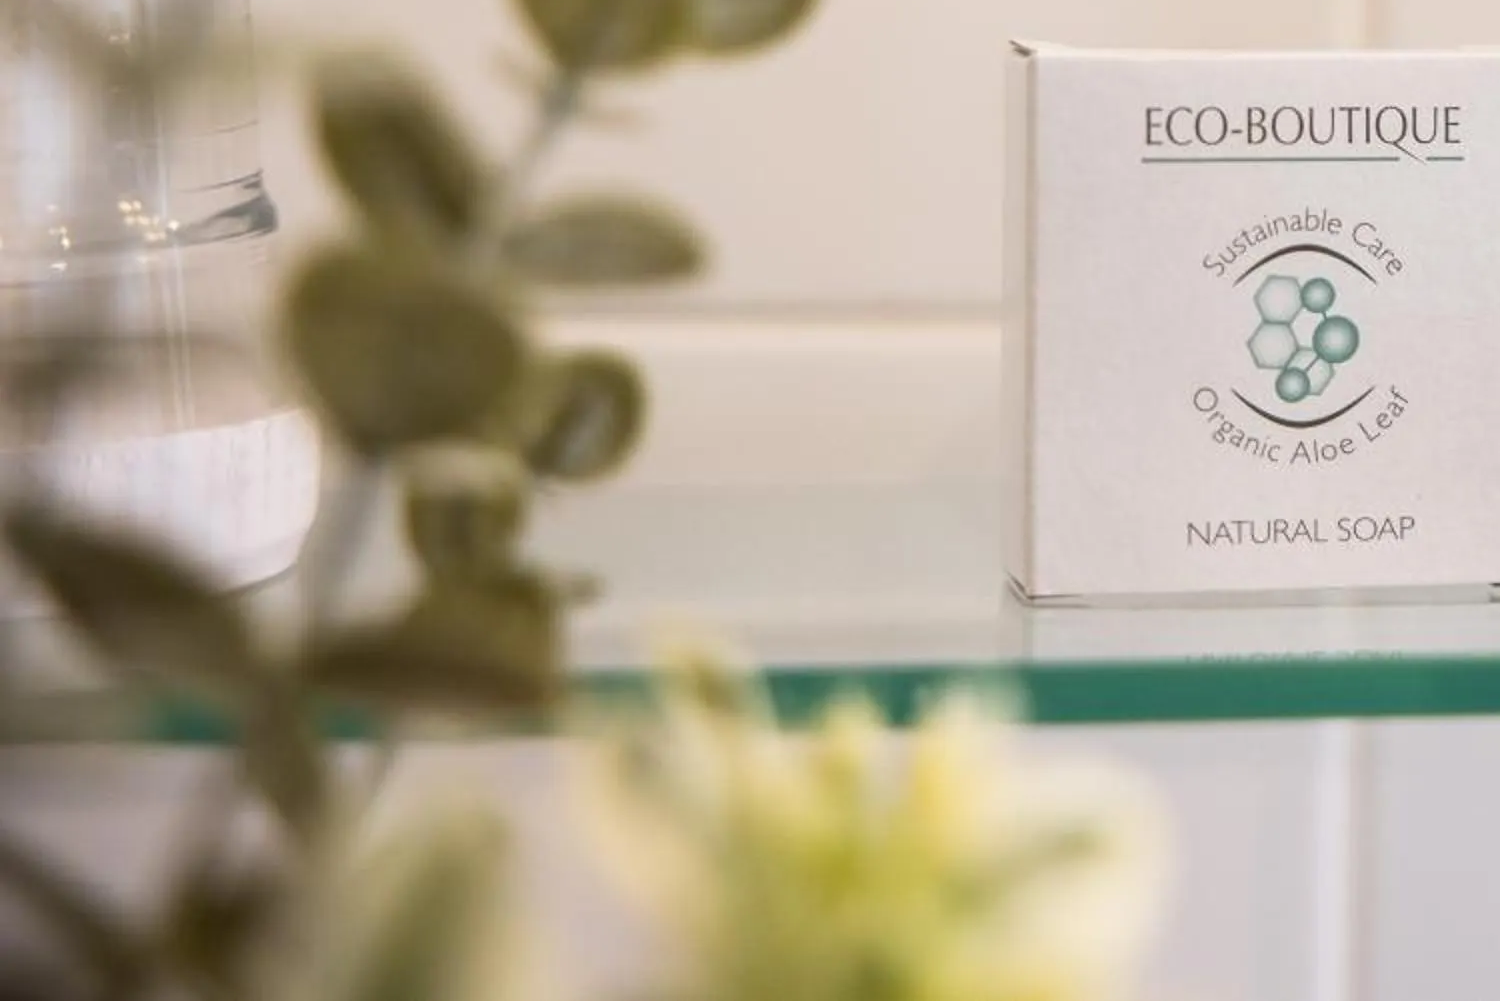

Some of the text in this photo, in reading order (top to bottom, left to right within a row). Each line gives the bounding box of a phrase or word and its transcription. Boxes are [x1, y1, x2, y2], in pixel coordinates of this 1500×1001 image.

[1144, 105, 1461, 163] ECO-BOUTIQUE
[1203, 206, 1404, 277] Sustainable Care
[1193, 384, 1409, 465] Organic Aloe Leaf
[1186, 516, 1416, 546] NATURAL SOAP
